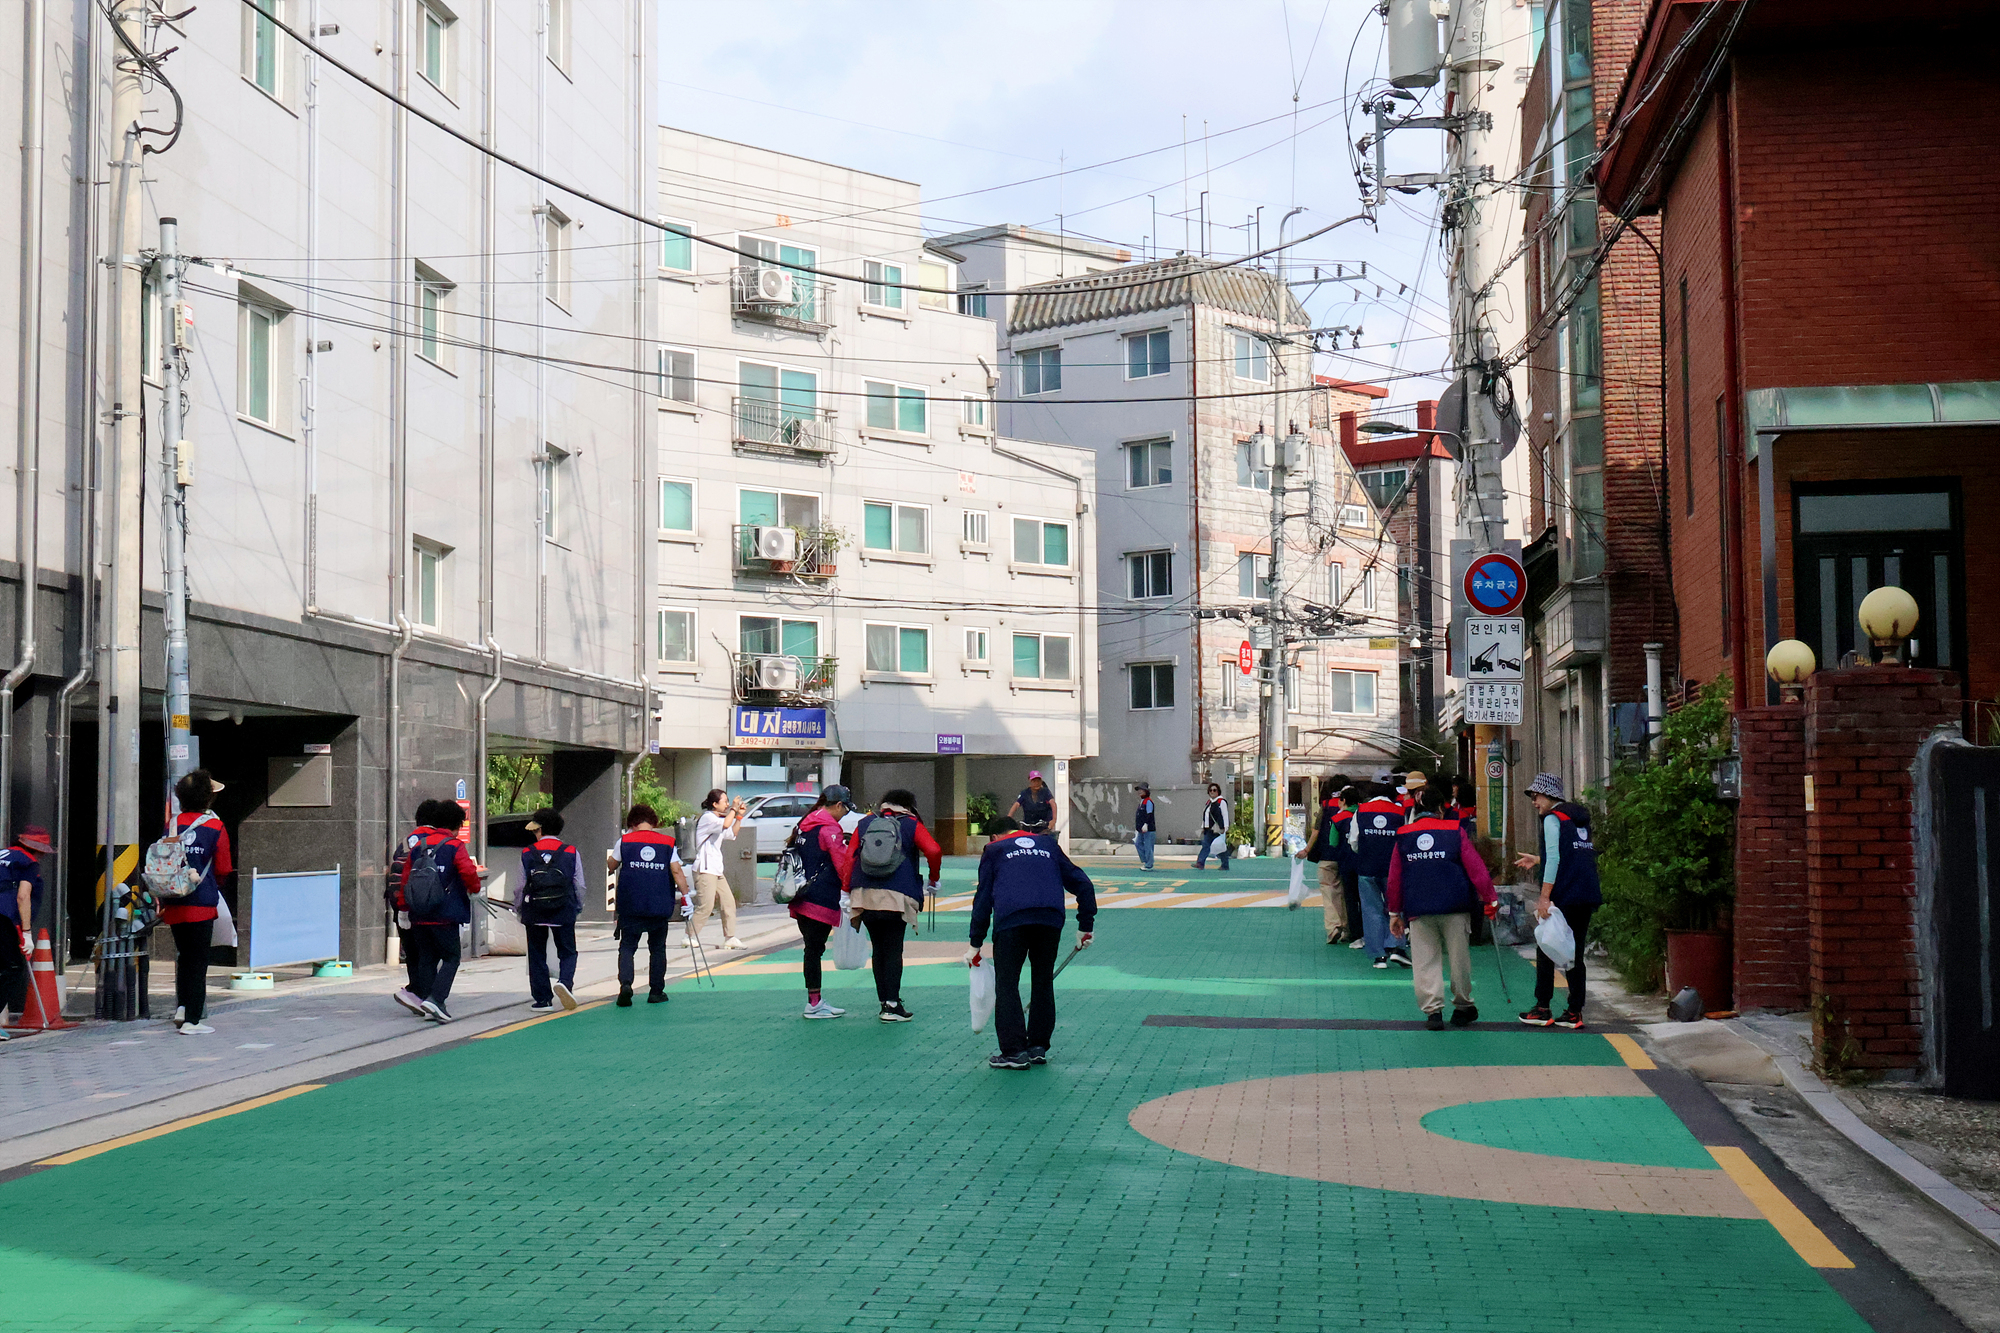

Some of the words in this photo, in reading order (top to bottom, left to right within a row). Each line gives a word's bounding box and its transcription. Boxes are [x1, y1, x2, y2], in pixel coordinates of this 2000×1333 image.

[1473, 580, 1517, 590] 주차금지
[1470, 623, 1520, 635] 견인지역
[740, 710, 781, 735] 대지
[741, 738, 780, 746] 3492-4774
[1491, 765, 1502, 774] 30
[1406, 850, 1446, 862] 한국자유총연맹
